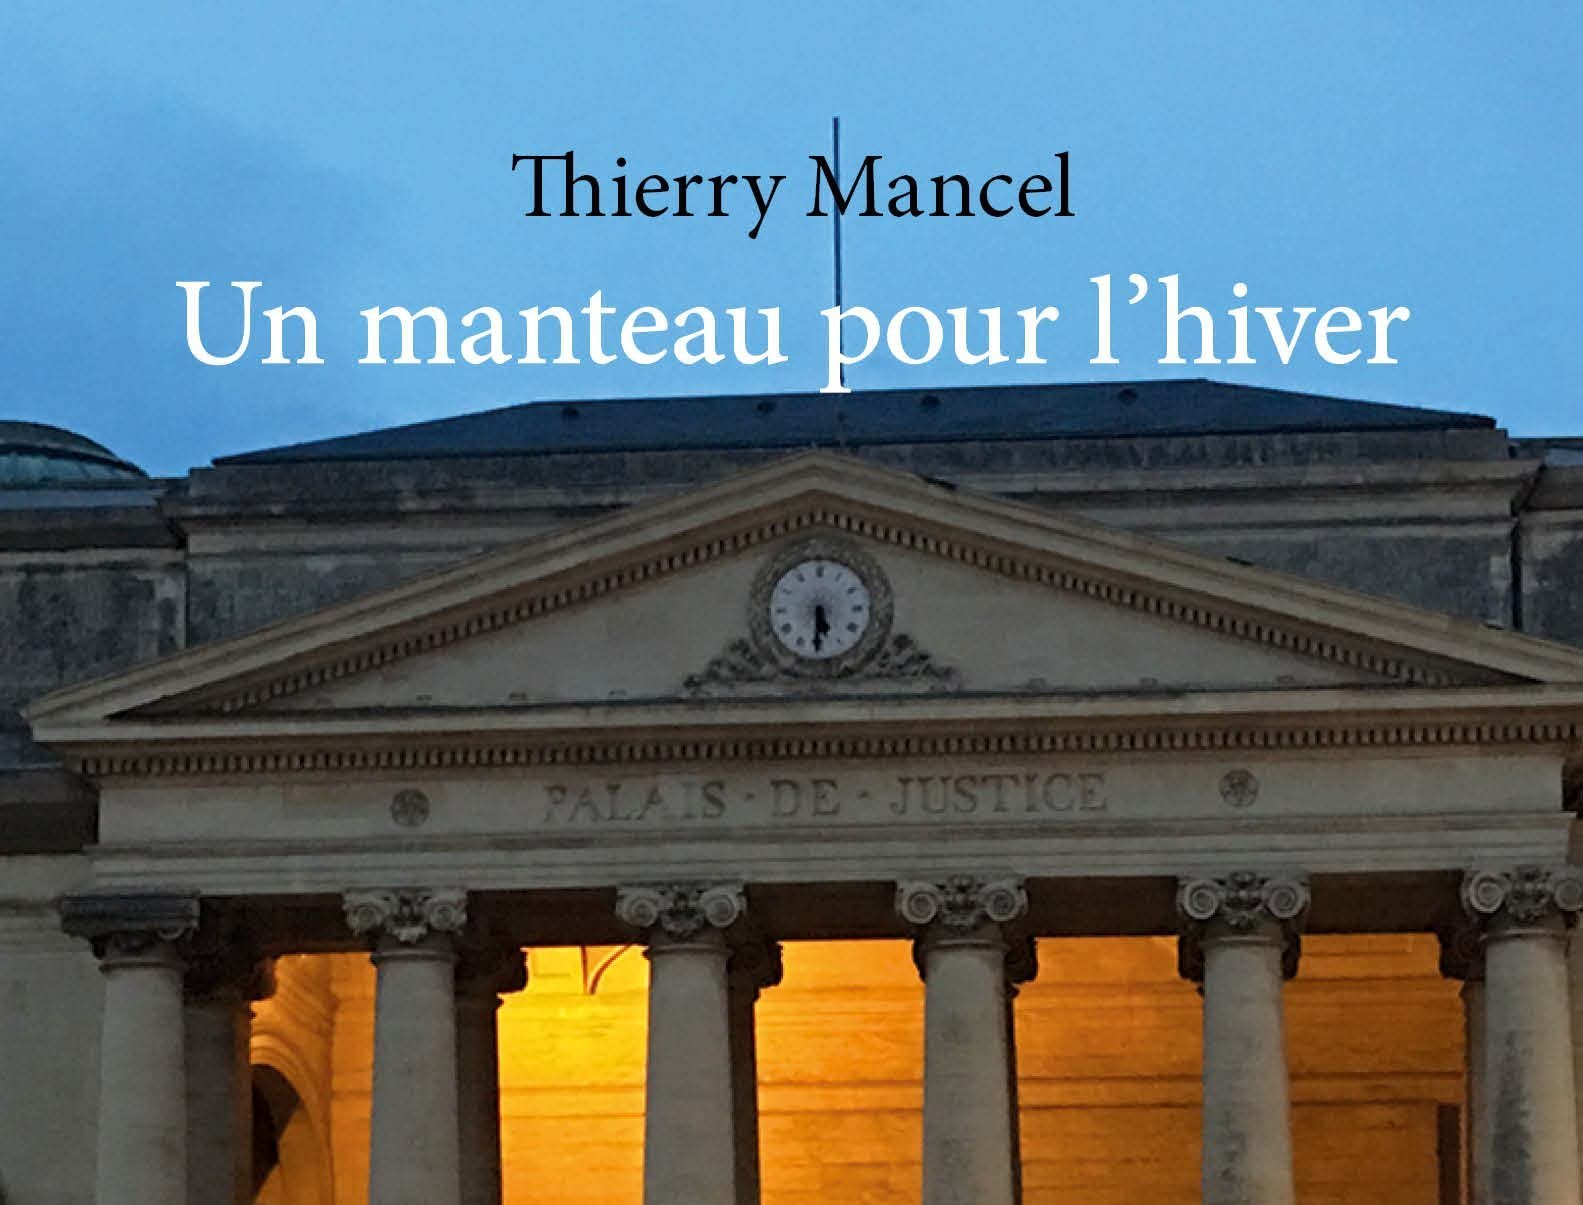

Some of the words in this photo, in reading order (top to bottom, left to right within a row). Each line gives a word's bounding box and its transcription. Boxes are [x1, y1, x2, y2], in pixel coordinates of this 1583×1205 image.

[543, 779, 727, 824] PALAIS
[770, 777, 841, 817] DE
[889, 772, 1108, 815] JUSTICE
